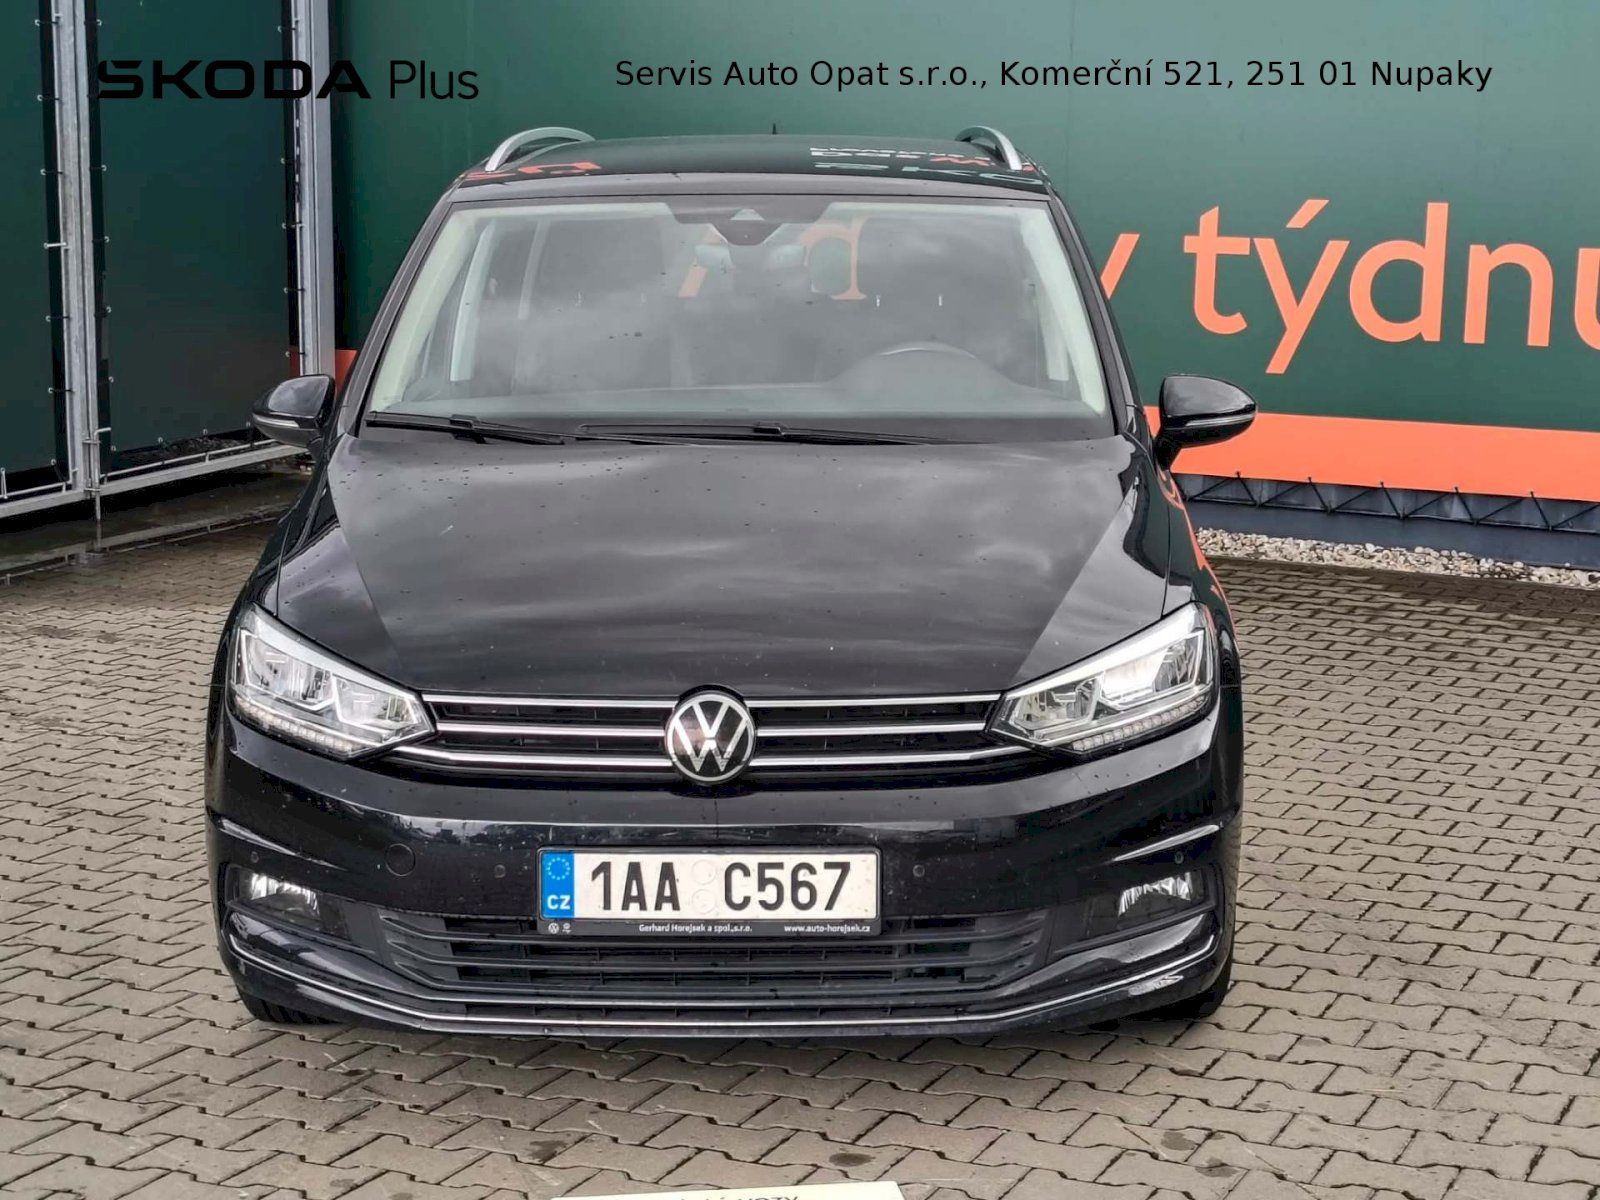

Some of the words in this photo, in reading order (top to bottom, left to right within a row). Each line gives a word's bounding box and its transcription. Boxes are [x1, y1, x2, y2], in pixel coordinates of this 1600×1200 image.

[591, 861, 681, 911] 1AA
[724, 861, 851, 911] C567
[547, 894, 571, 910] CZ
[638, 922, 669, 934] Gerhard
[707, 925, 713, 934] a
[783, 923, 871, 935] www.auto-horejsek.cz
